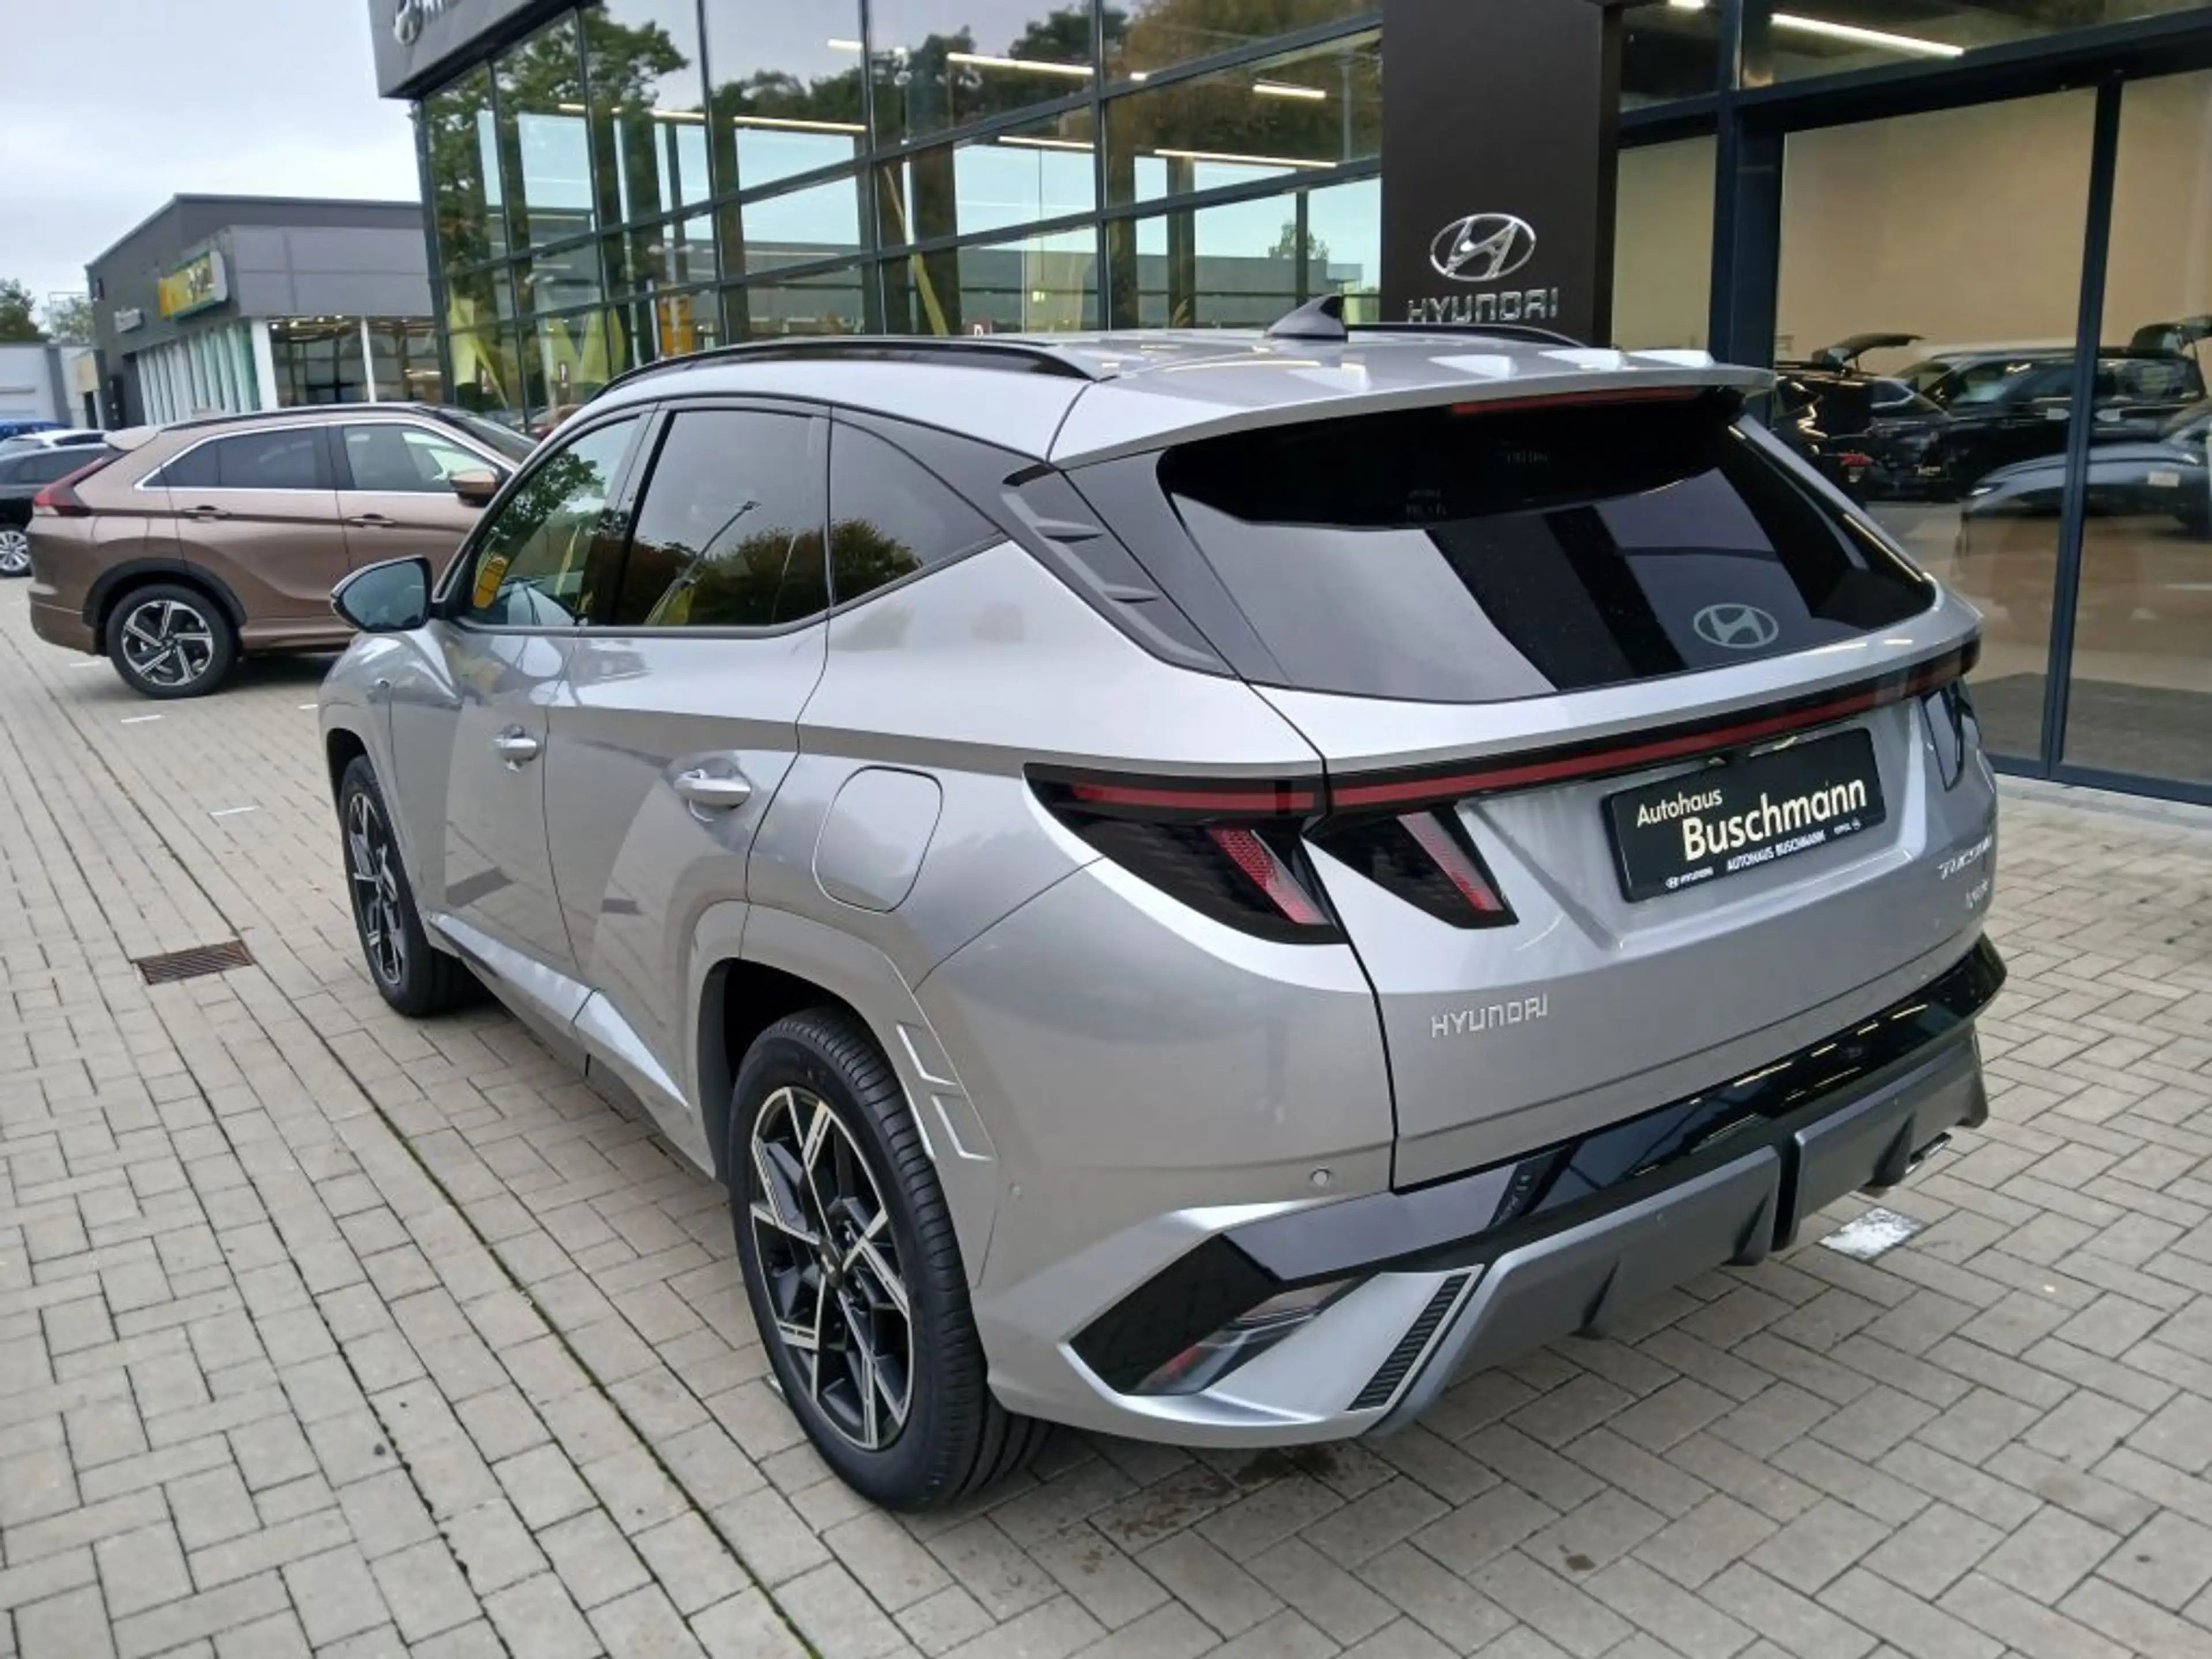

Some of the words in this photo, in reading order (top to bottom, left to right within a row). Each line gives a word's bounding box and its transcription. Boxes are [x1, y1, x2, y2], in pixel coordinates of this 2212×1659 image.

[1408, 287, 1558, 324] HYUNDAI
[1637, 788, 1723, 828] Autohaus
[1682, 779, 1867, 862] Buschmann
[1431, 993, 1548, 1038] HYUNDAI
